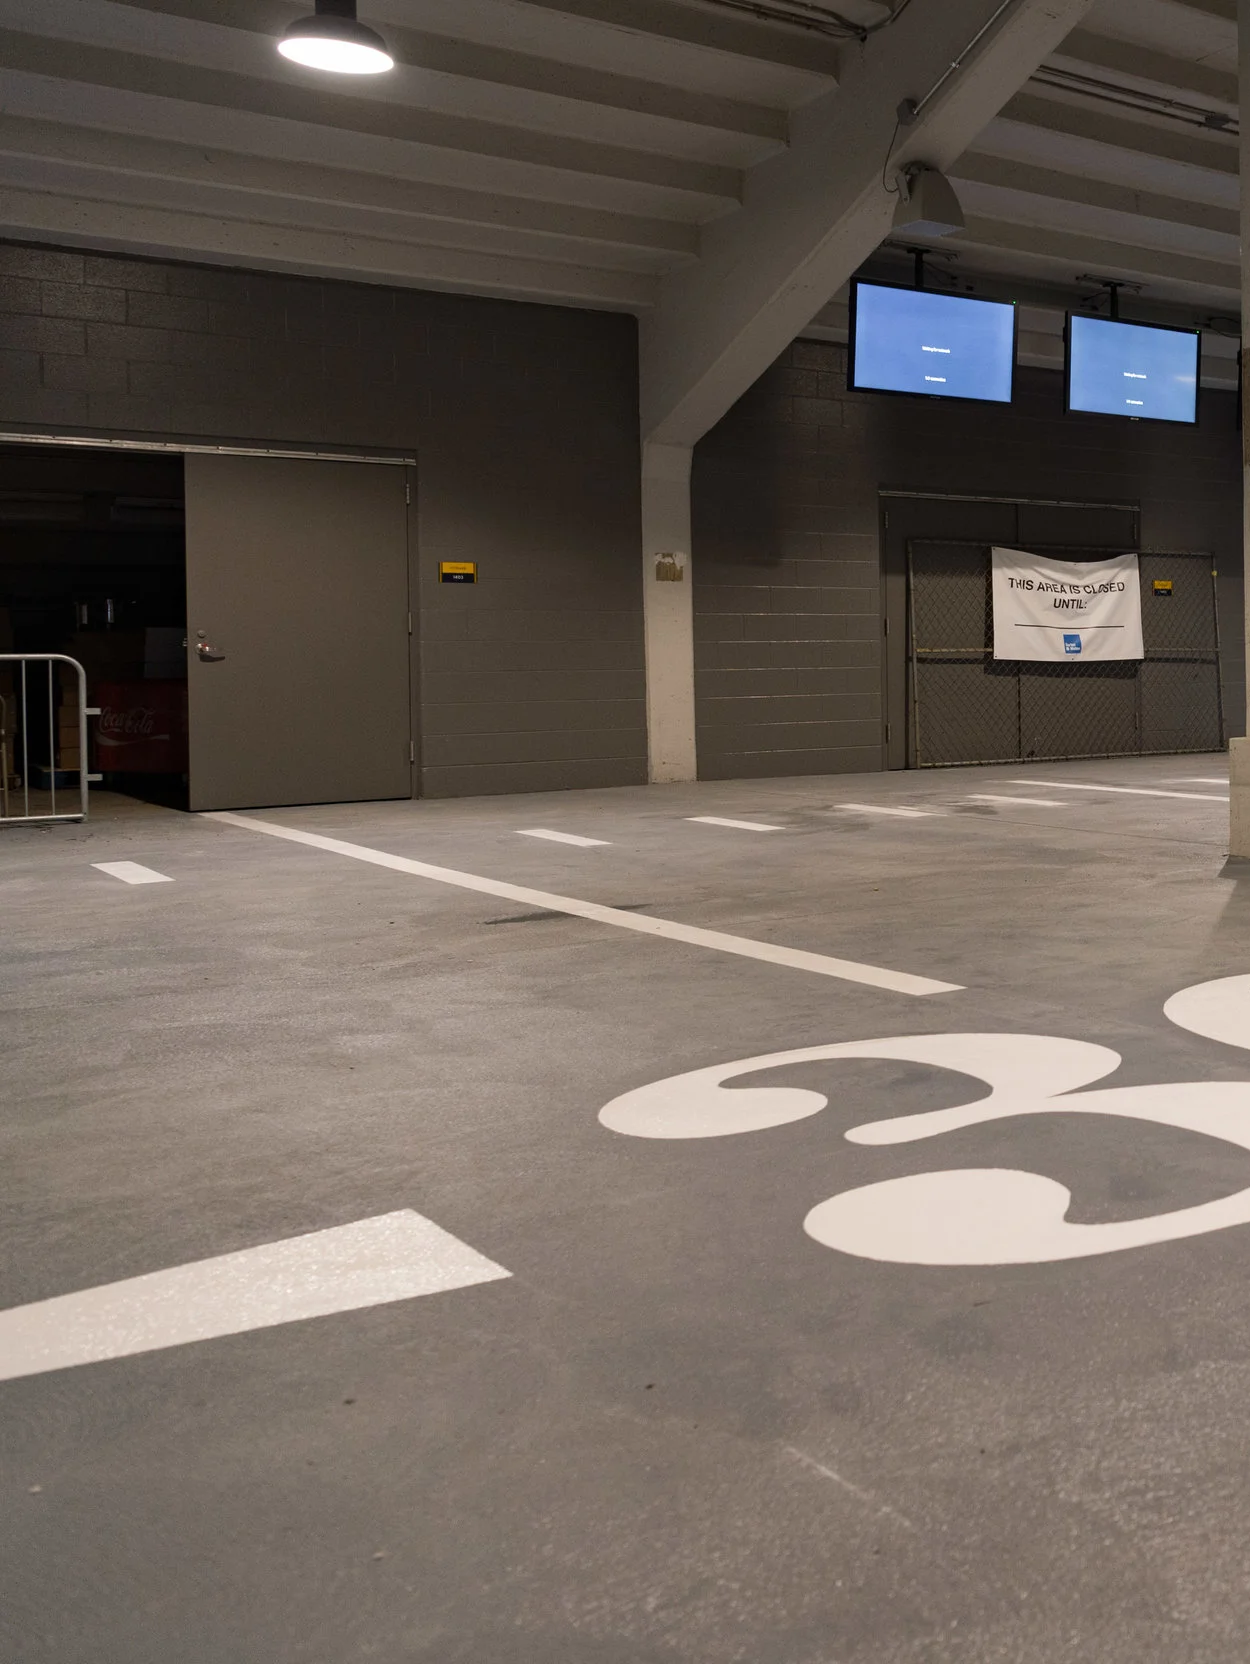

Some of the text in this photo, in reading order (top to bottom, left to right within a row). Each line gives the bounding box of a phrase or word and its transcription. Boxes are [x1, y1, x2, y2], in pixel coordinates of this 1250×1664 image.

[1008, 577, 1125, 595] THIS AREA IS CLOSED
[1053, 598, 1088, 610] UNTIL:
